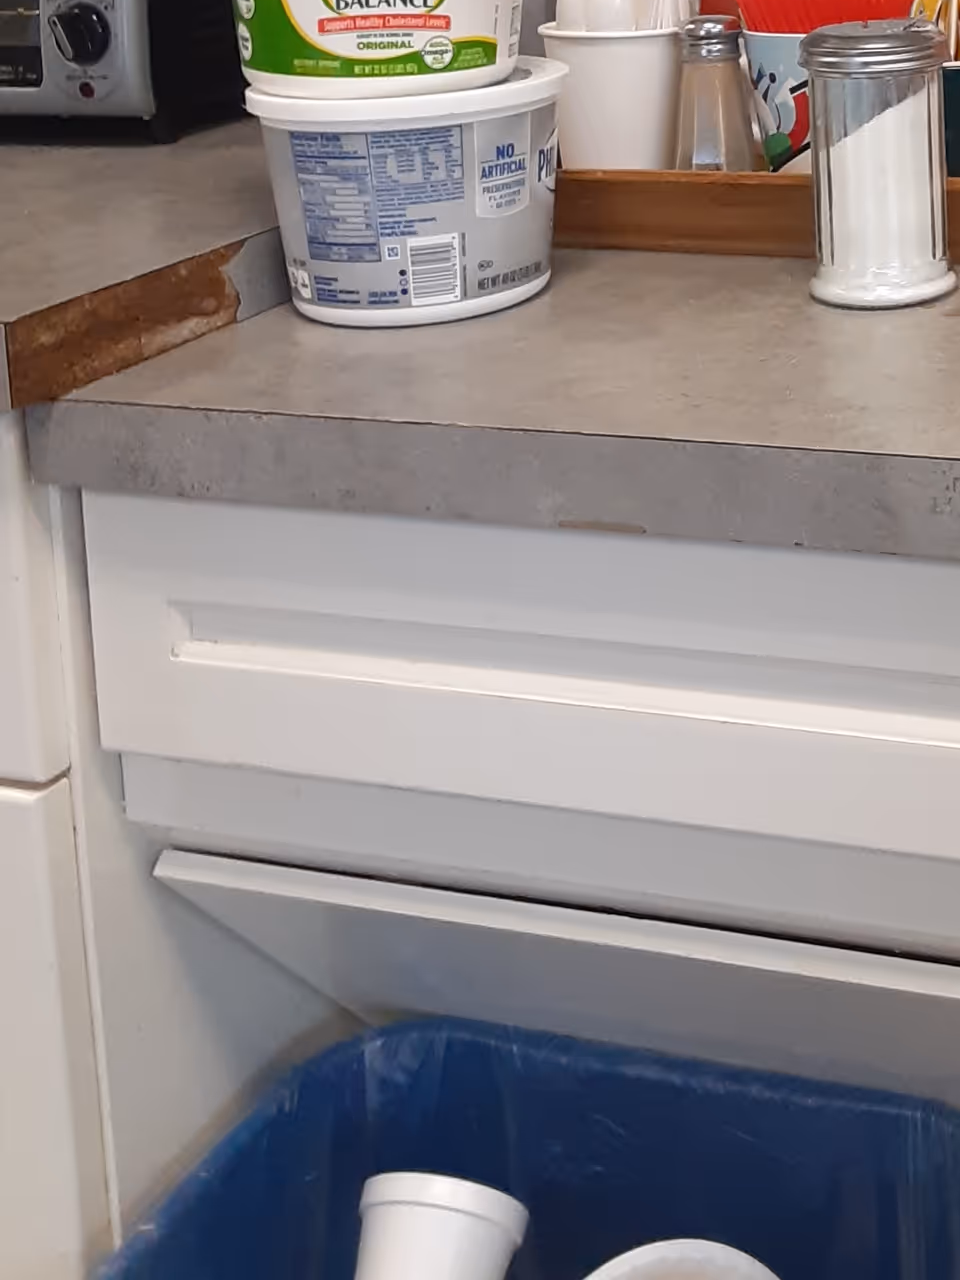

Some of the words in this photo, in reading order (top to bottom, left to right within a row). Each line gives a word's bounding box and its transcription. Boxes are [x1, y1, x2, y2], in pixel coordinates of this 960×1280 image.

[356, 40, 414, 51] ORIGINAL
[495, 142, 515, 161] NO
[480, 157, 527, 180] ARTIFICIAL
